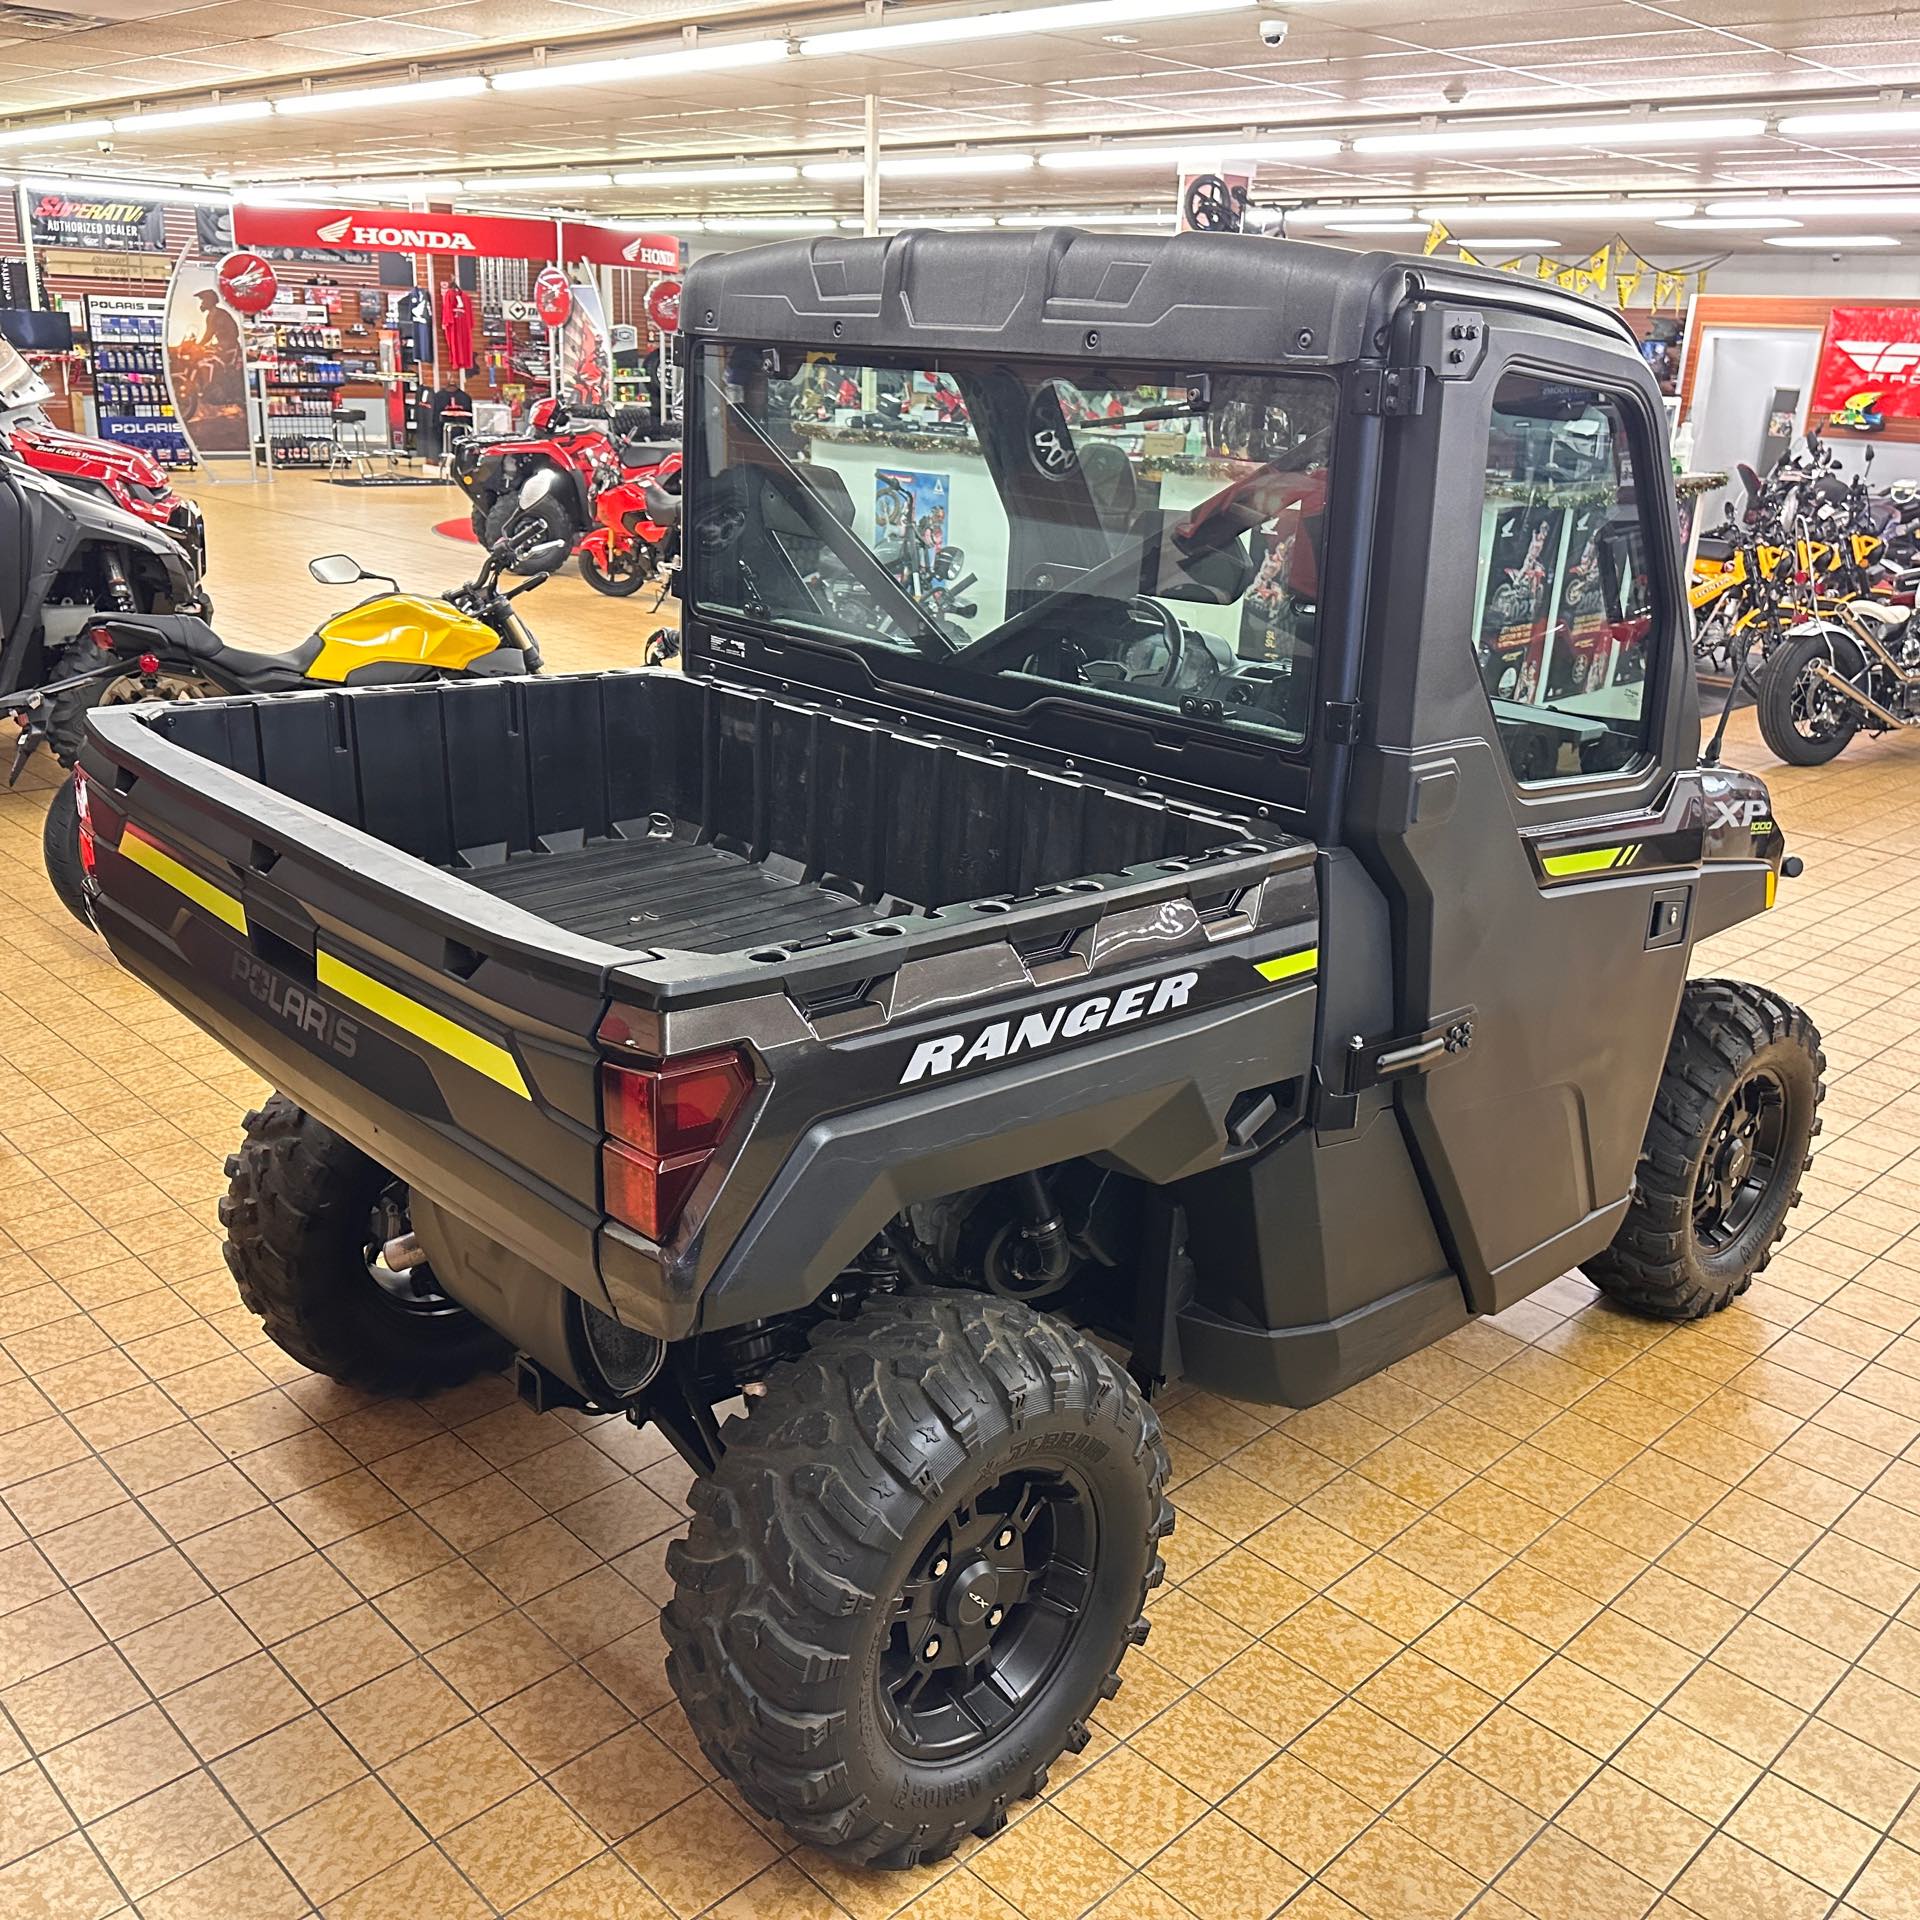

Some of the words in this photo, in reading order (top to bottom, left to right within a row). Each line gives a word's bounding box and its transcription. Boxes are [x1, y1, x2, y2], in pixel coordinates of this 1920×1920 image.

[47, 220, 103, 235] AUTHORIZED
[105, 224, 138, 236] DEALER
[352, 227, 476, 250] HONDA
[90, 300, 145, 310] POLARIS
[111, 422, 183, 434] POLARIS
[1708, 800, 1768, 830] XP
[1750, 821, 1772, 832] 1000
[231, 951, 358, 1058] POLARIS
[899, 972, 1199, 1085] RANGER
